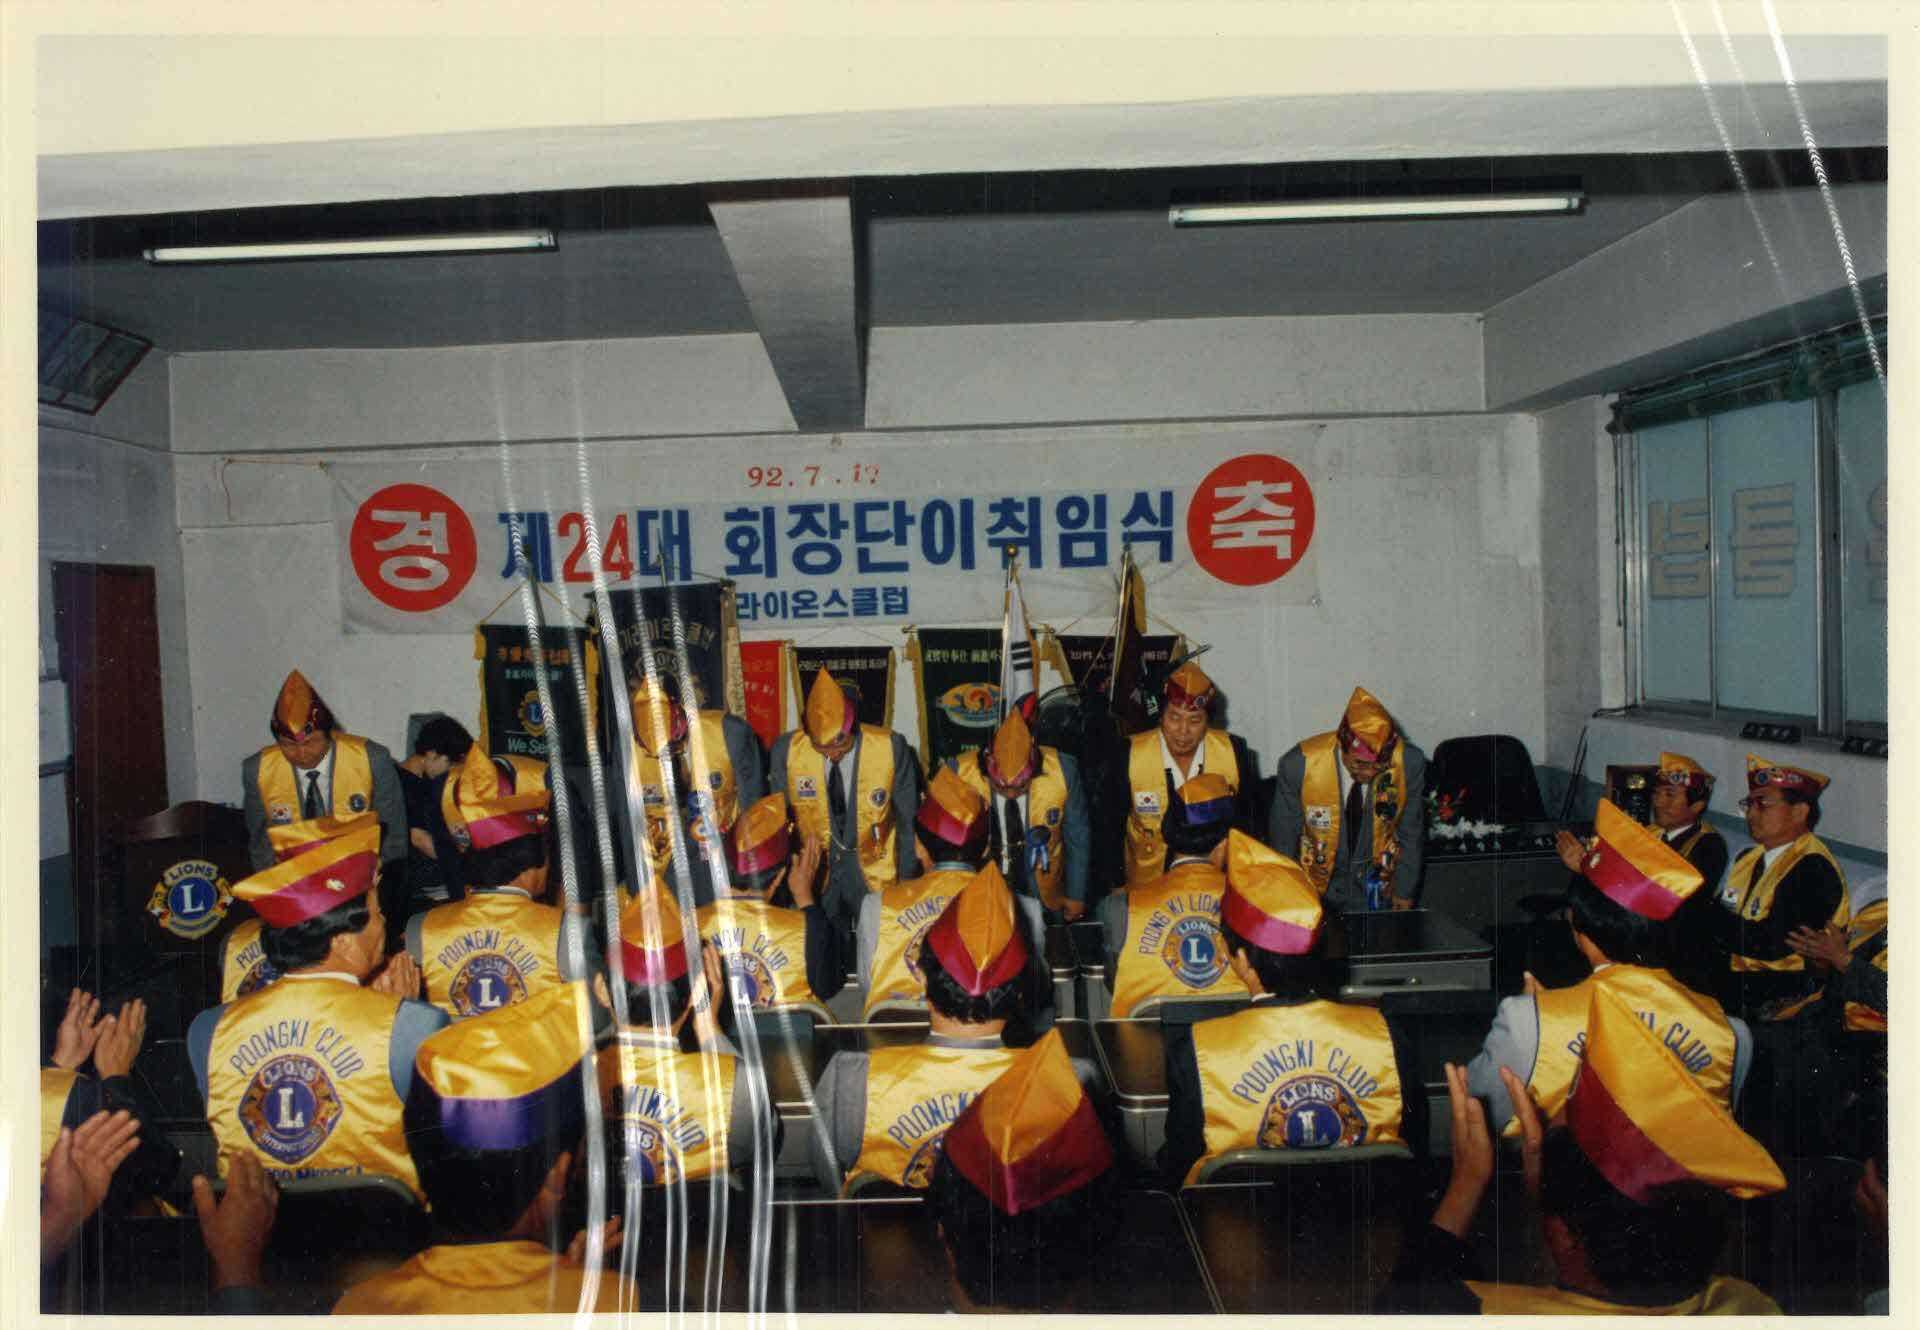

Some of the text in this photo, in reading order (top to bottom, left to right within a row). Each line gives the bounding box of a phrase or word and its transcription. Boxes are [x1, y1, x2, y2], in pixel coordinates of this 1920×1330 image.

[1210, 480, 1296, 560] 축
[371, 508, 449, 591] 경
[170, 863, 214, 881] LIONS
[181, 884, 205, 913] L
[1178, 920, 1217, 940] LIONS
[1187, 938, 1209, 963] L
[479, 978, 502, 1007] L
[230, 1019, 365, 1080] POONGKI CLUB
[1664, 1022, 1713, 1073] CLUB
[265, 1061, 317, 1083] LIONS
[1232, 1039, 1379, 1104] POONGKI CLUB
[276, 1087, 305, 1128] L
[1280, 1082, 1337, 1107] LIONS
[887, 1091, 978, 1149] POONGK
